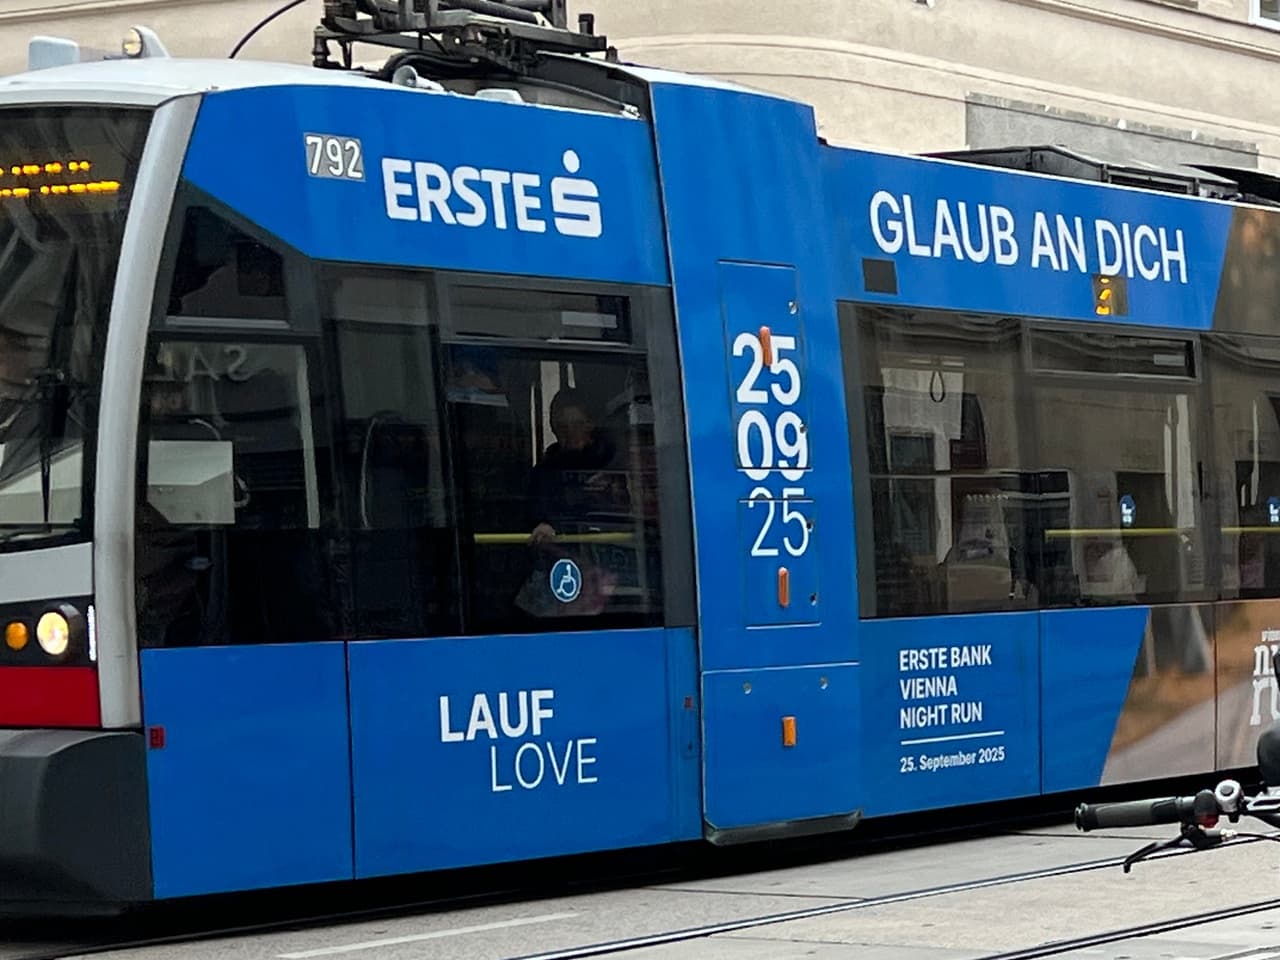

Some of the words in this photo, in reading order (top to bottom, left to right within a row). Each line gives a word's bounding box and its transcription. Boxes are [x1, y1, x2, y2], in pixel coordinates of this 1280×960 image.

[306, 136, 363, 178] 792
[382, 158, 546, 233] ERSTE
[870, 190, 1019, 266] GLAUB
[1031, 212, 1087, 273] AN
[1095, 219, 1188, 284] DICH
[733, 332, 801, 405] 25
[737, 410, 808, 481] 09
[749, 486, 810, 557] 25
[899, 647, 948, 672] ERSTE
[950, 644, 992, 668] BANK
[899, 675, 958, 700] VIENNA
[440, 690, 555, 743] LAUF
[900, 704, 949, 729] NIGHT
[951, 701, 983, 725] RUN
[490, 738, 598, 792] LOVE
[900, 756, 917, 773] 25.
[919, 751, 977, 772] September
[978, 746, 1005, 764] 2025
